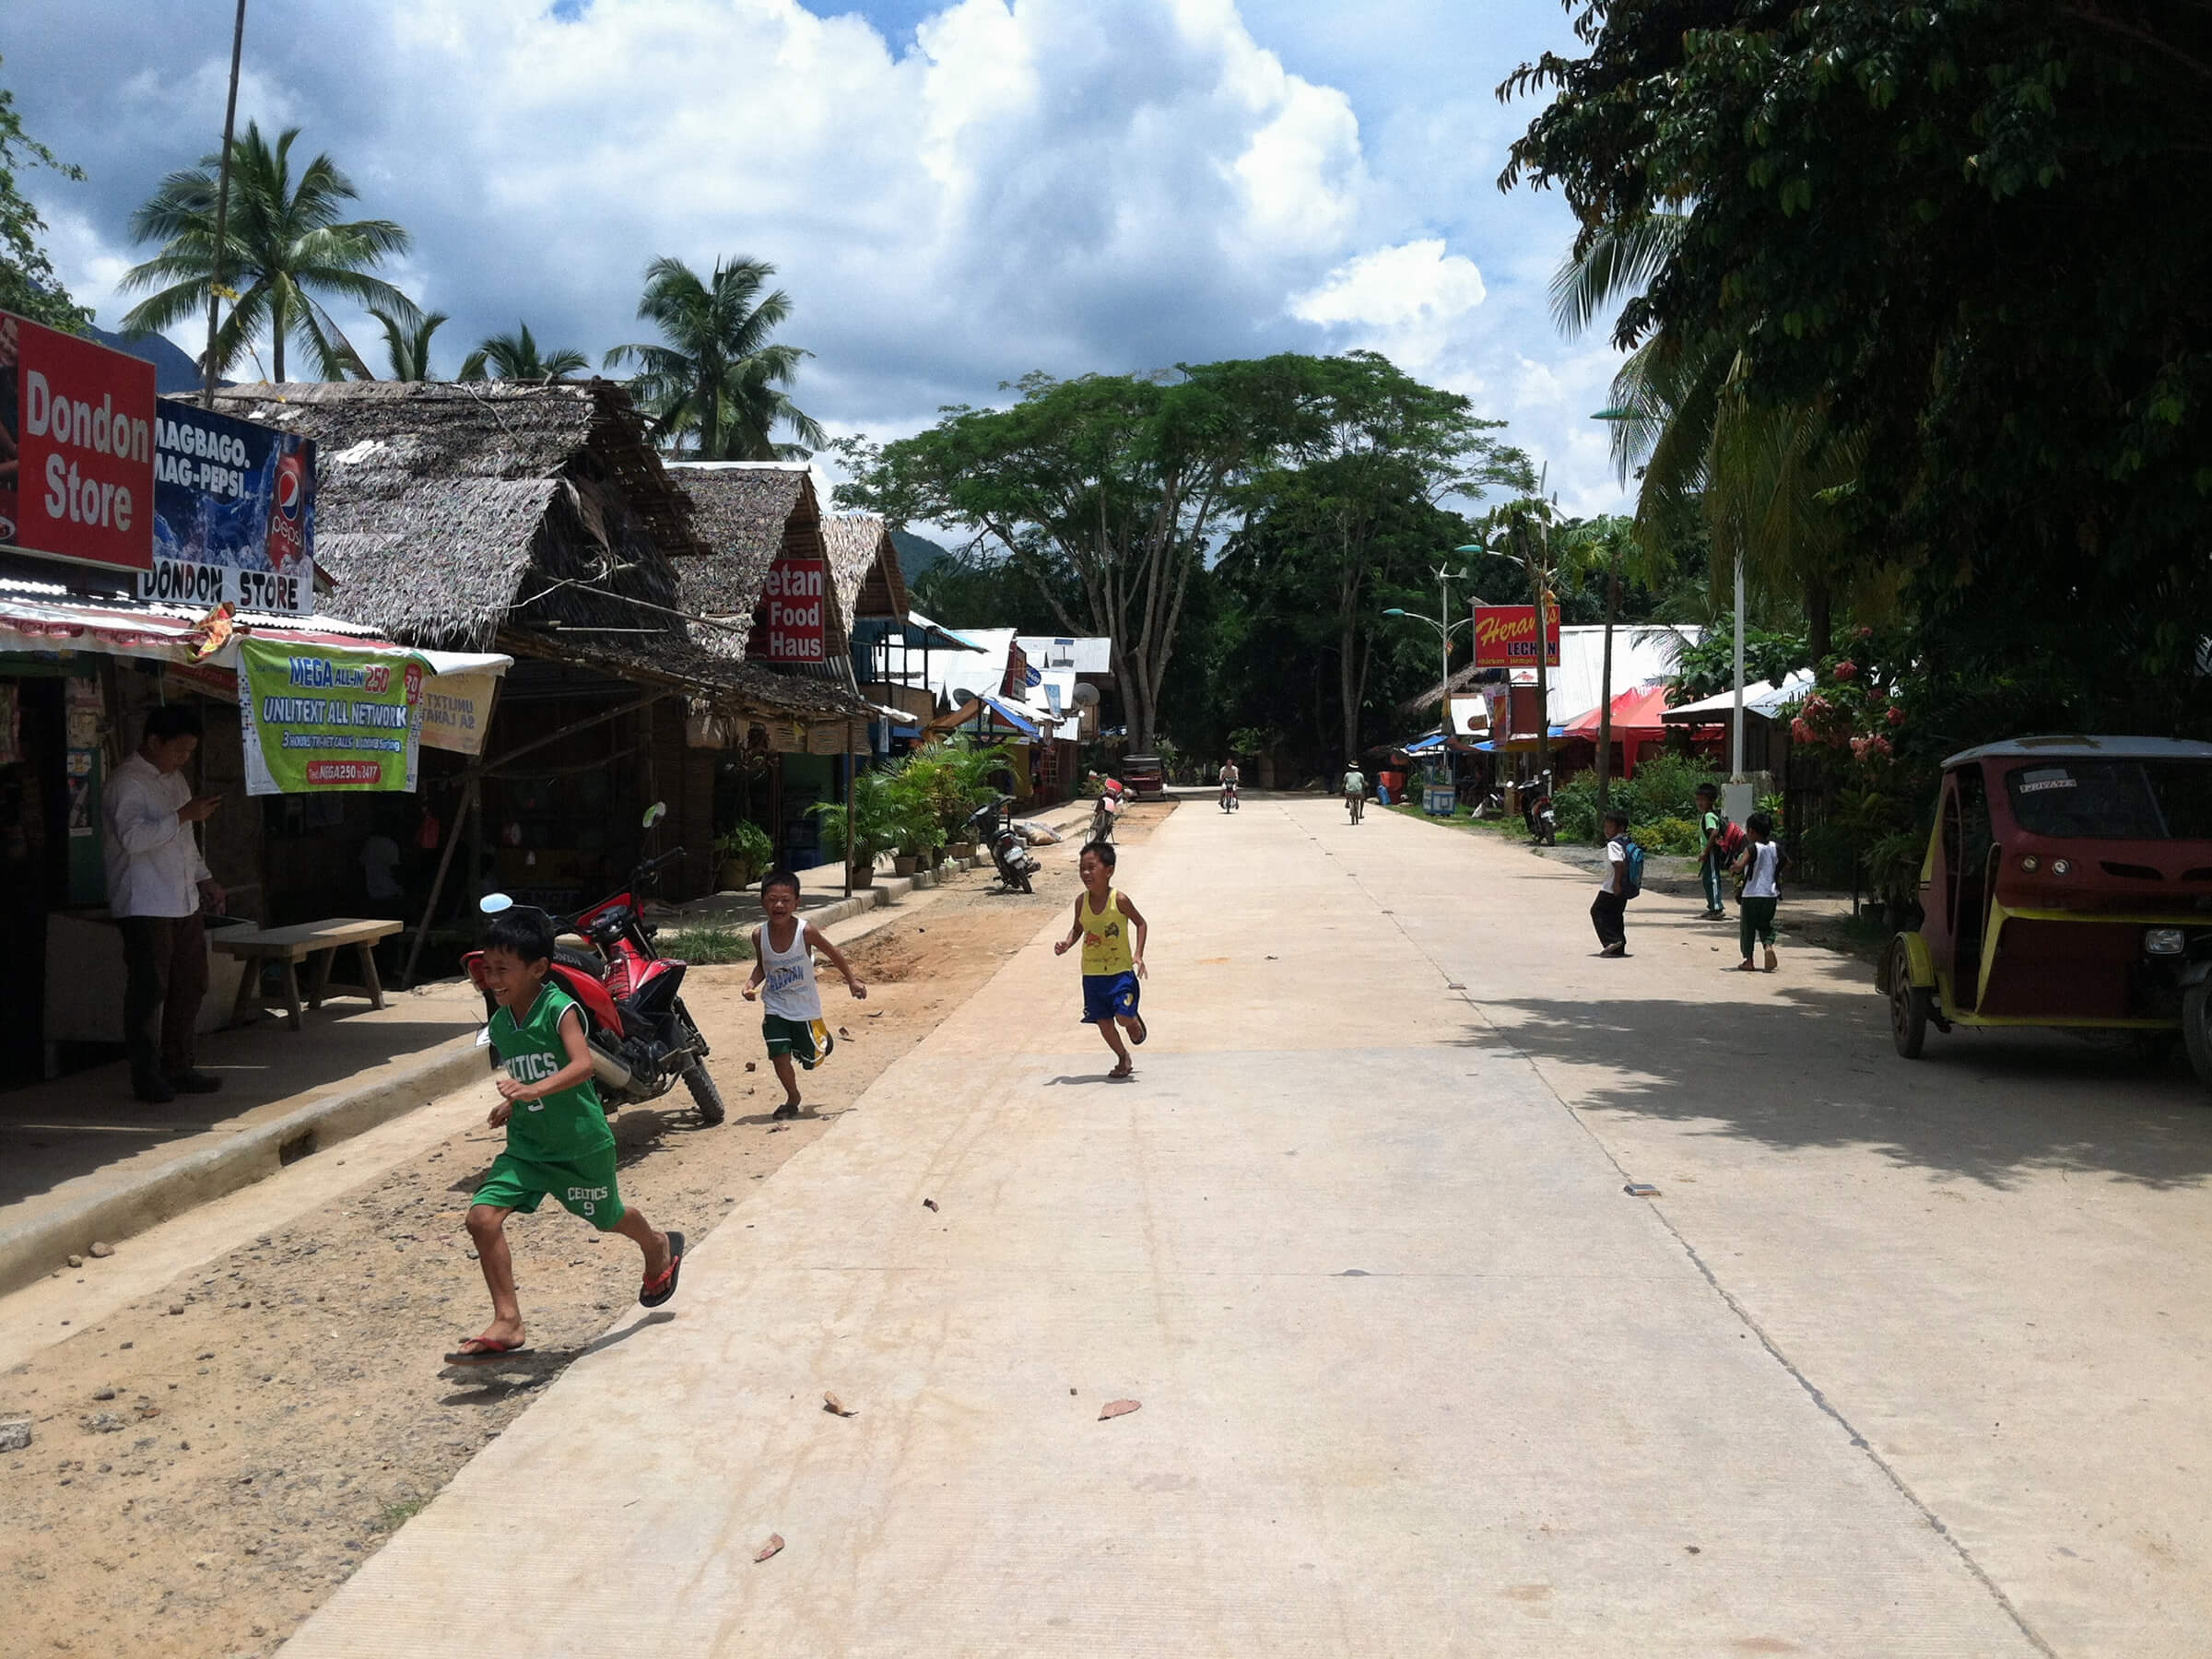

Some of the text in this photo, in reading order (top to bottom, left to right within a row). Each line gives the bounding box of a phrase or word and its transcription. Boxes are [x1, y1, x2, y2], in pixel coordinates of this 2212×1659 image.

[27, 369, 148, 464] Dondon
[44, 453, 133, 532] Store
[144, 560, 299, 610] DONDON STORE
[766, 563, 822, 596] etan
[771, 601, 819, 627] Food
[770, 631, 821, 657] Haus
[1507, 641, 1556, 655] LECHN
[288, 656, 391, 694] MEGA ALL-IN 250
[263, 697, 407, 728] UNLITEXT ALL NETWORK
[282, 731, 289, 747] 3
[568, 1187, 608, 1202] CELTICS
[583, 1202, 594, 1217] 9
